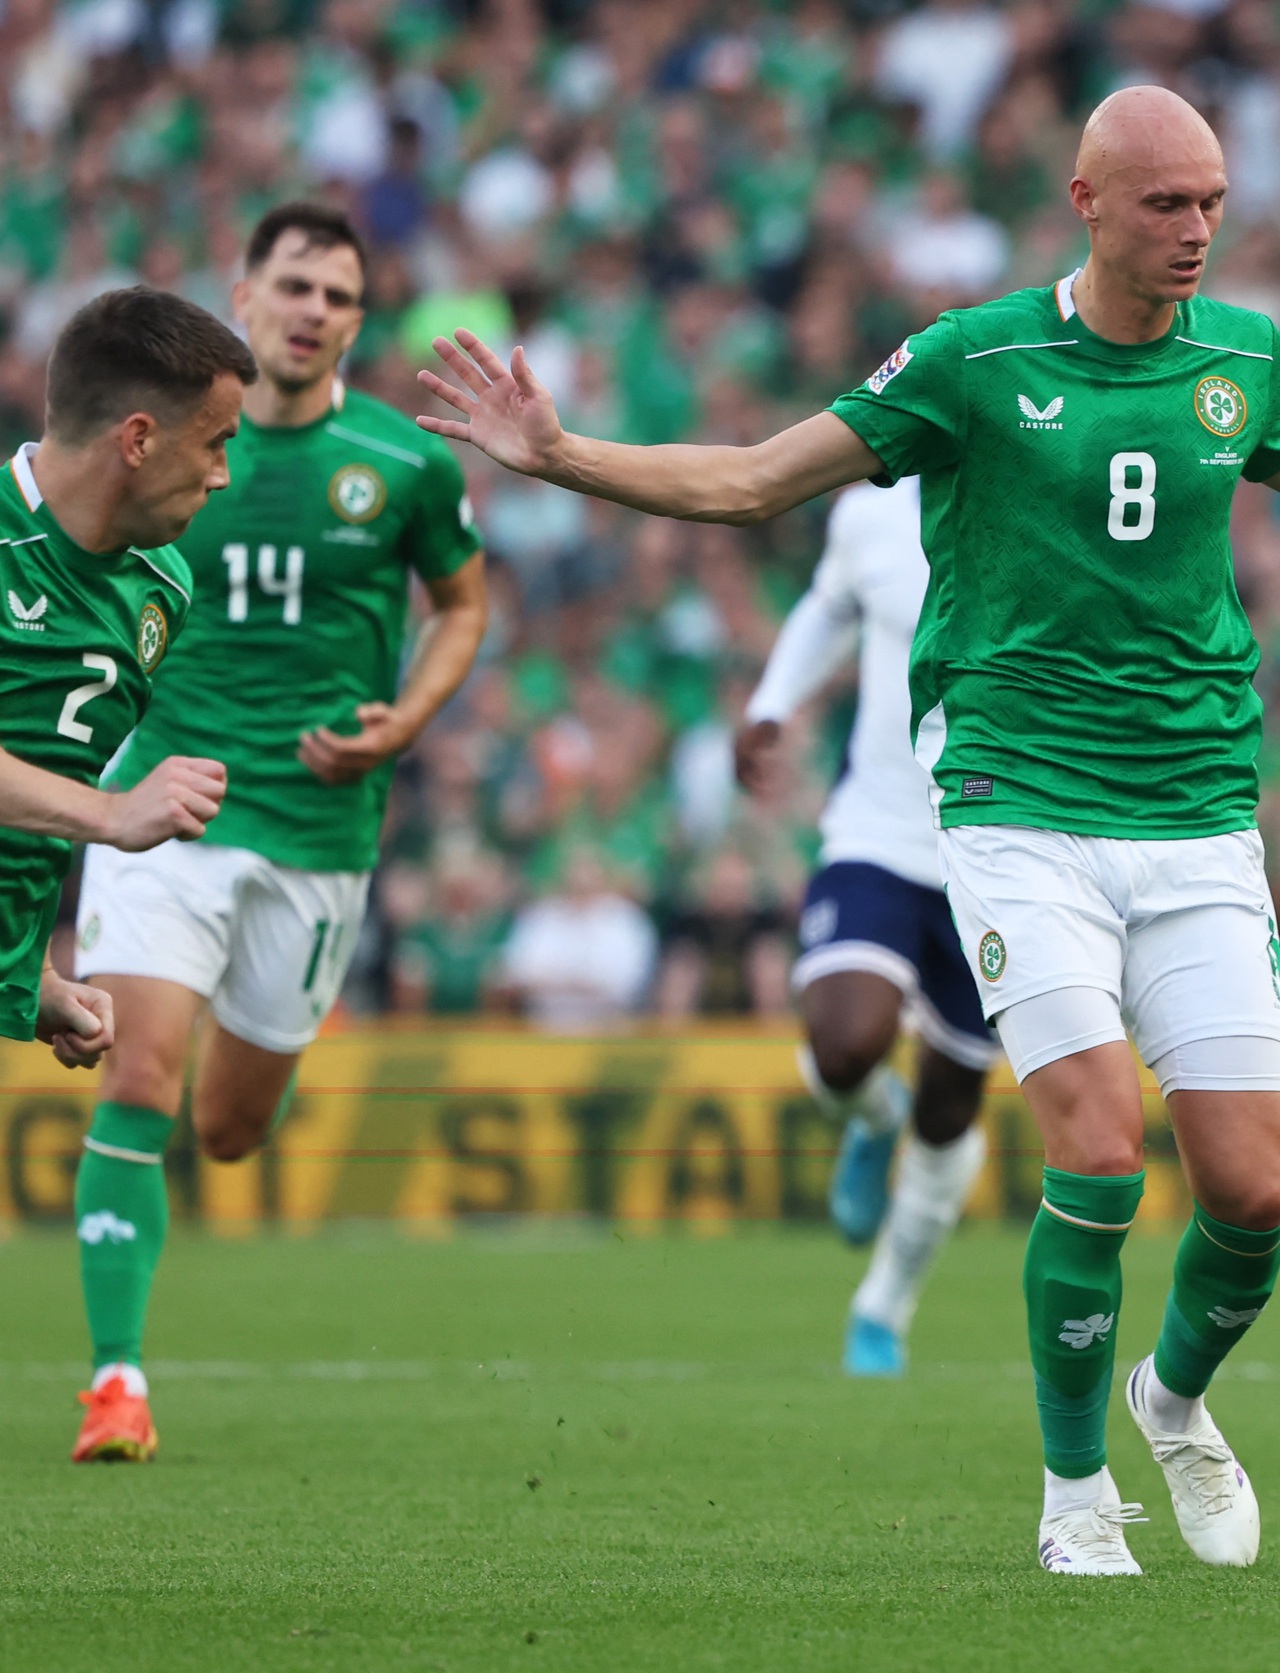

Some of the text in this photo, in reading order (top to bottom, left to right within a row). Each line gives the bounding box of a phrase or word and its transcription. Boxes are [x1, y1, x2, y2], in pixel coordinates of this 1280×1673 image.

[1019, 421, 1064, 430] CASTORE
[1198, 380, 1238, 399] IRELAND
[1107, 452, 1157, 541] 8
[221, 542, 306, 625] 14
[57, 652, 118, 744] 2
